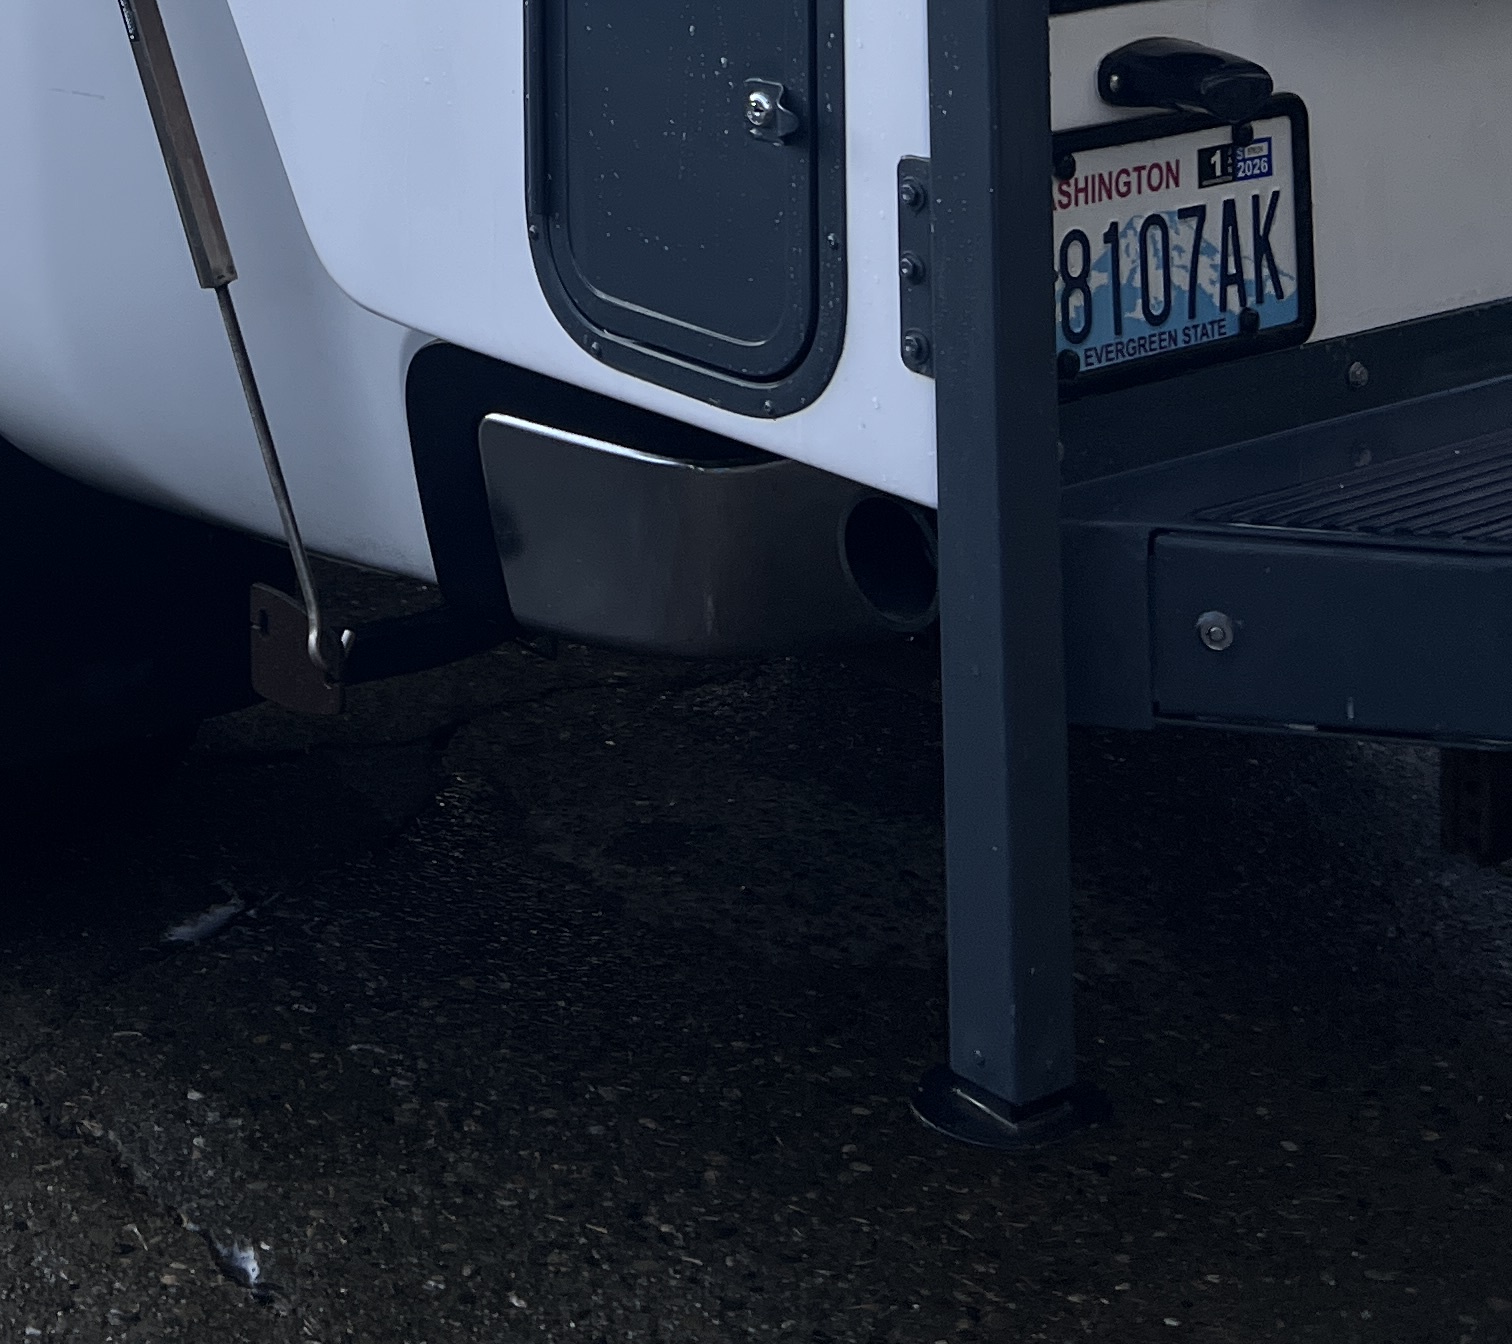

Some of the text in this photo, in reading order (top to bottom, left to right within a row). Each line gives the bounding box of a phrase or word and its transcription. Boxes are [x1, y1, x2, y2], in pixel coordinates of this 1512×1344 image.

[1210, 149, 1222, 177] 1
[1236, 157, 1269, 178] 2026
[1053, 159, 1181, 211] SHINGTON
[1083, 317, 1227, 368] EVERGREEN STATE
